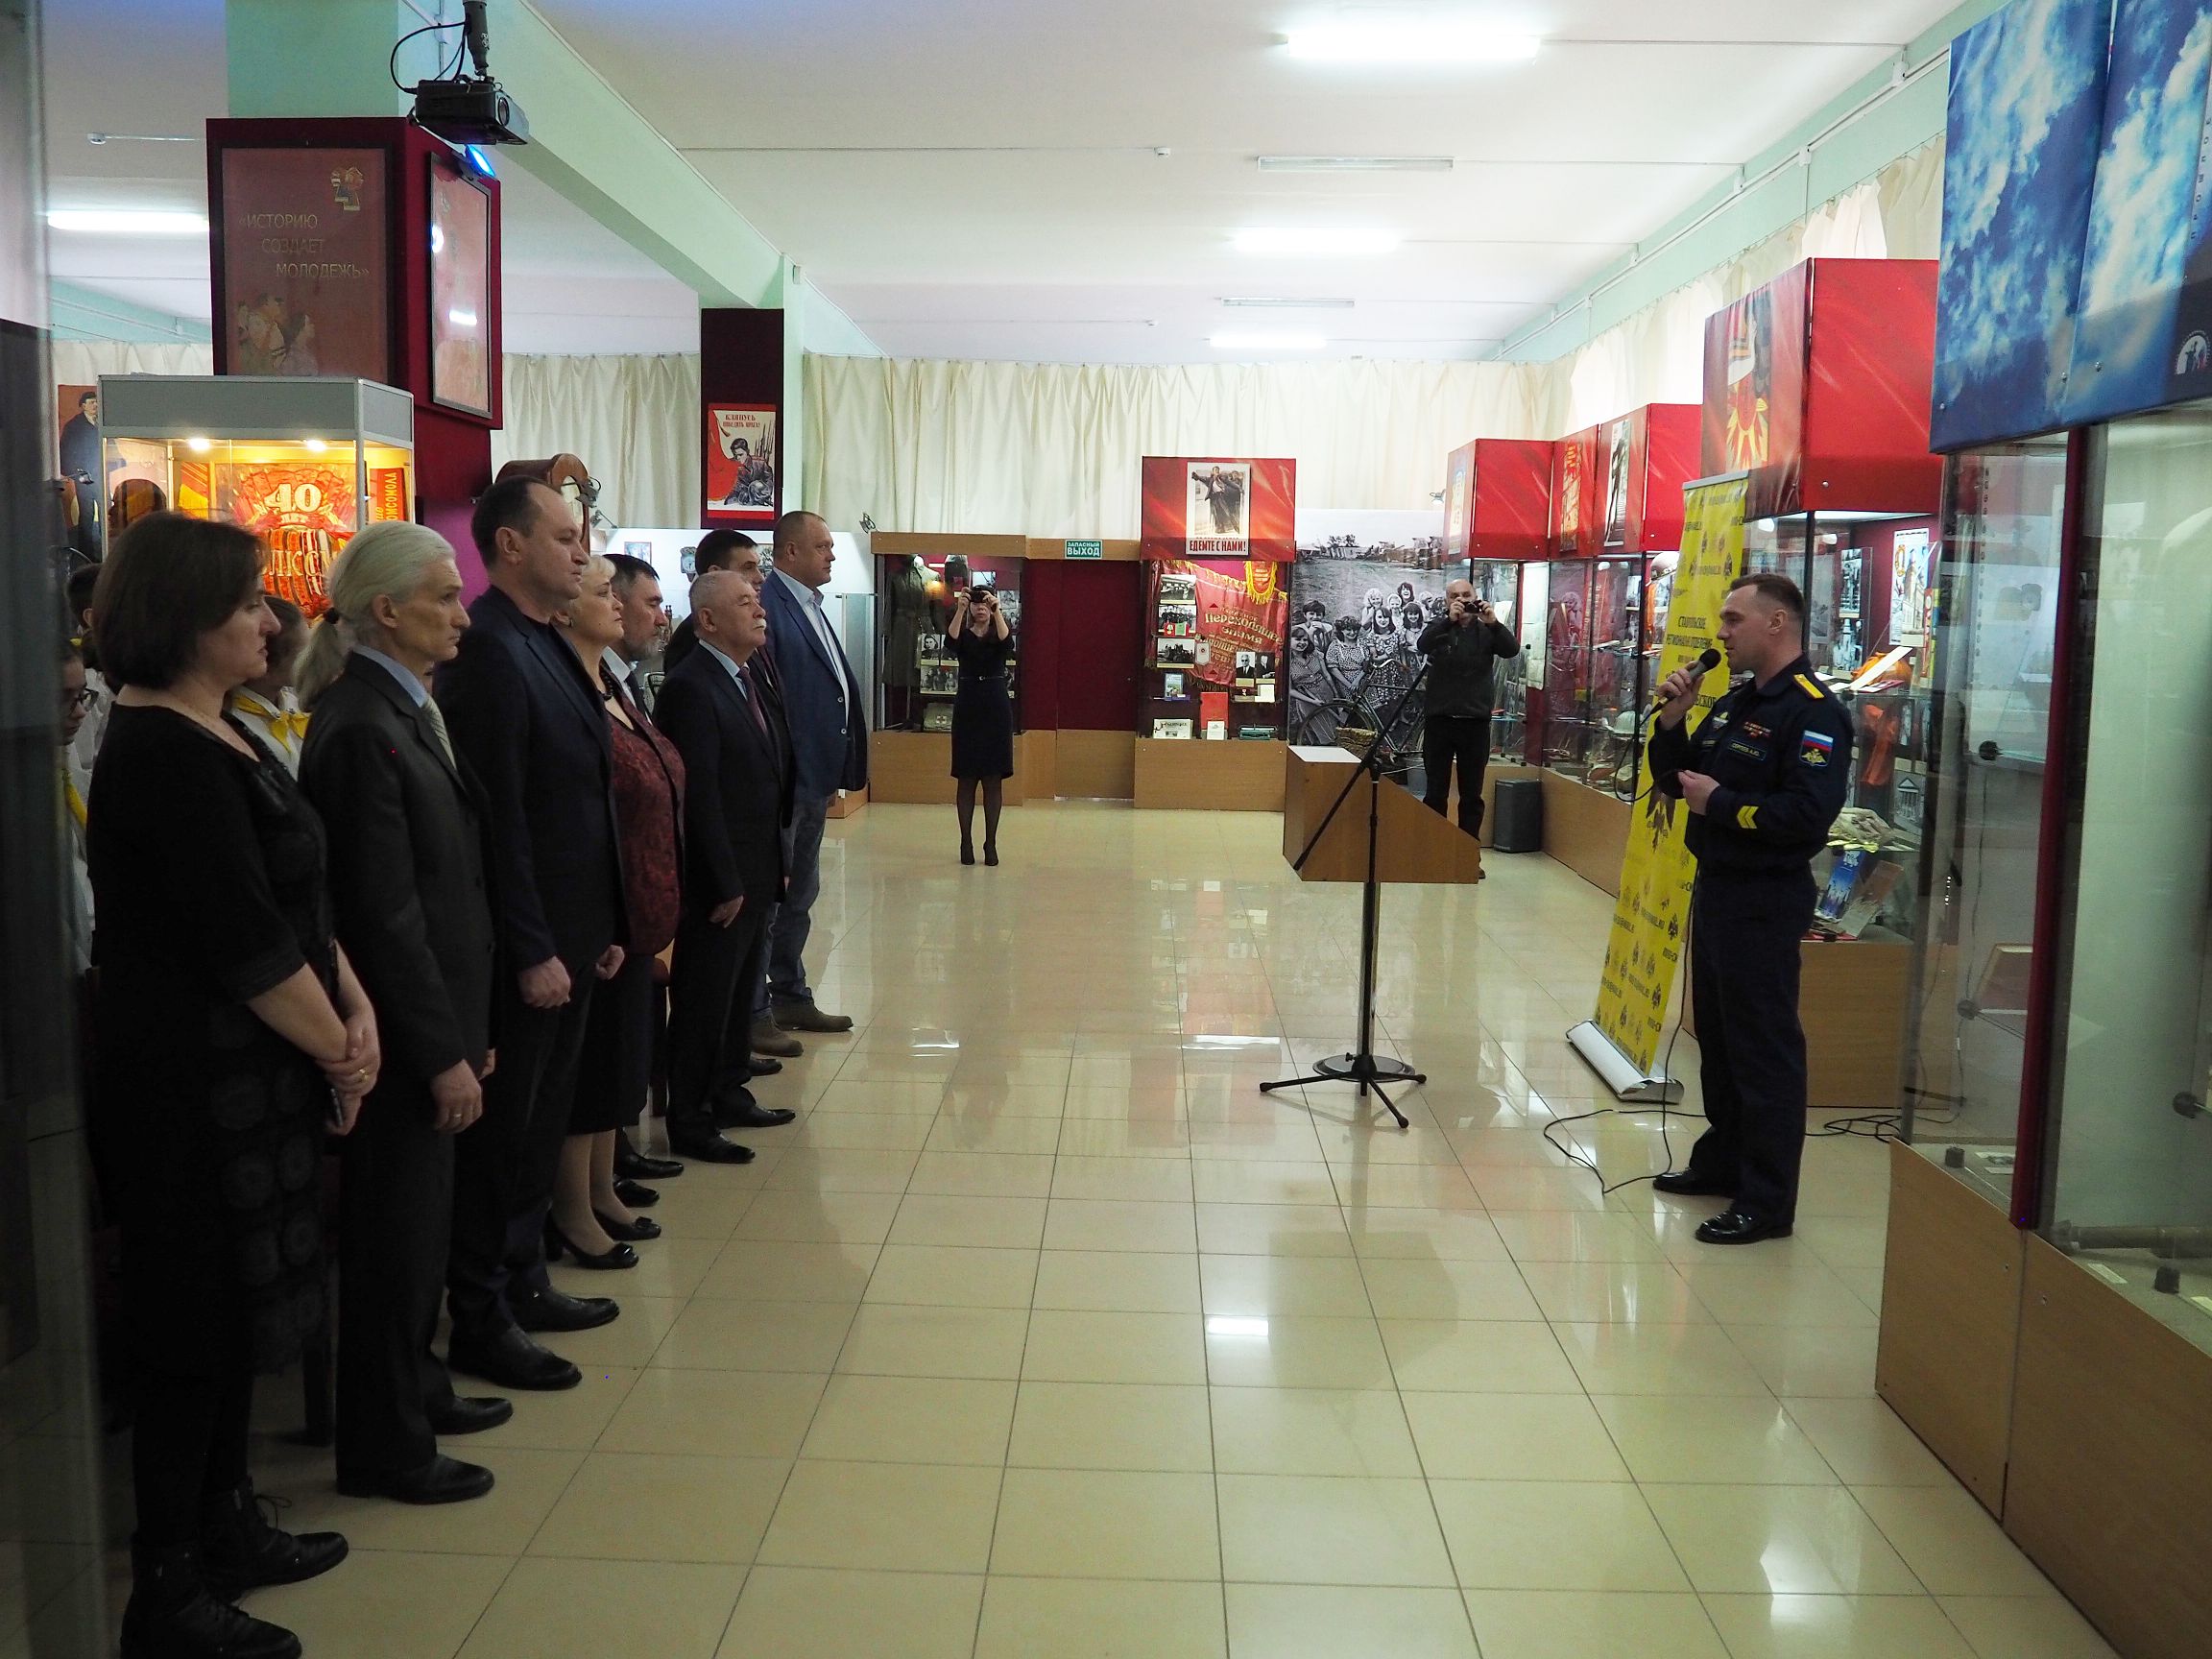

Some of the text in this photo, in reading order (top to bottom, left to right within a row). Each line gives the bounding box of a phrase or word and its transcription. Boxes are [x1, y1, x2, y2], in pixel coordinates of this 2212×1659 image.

[264, 483, 322, 513] 40
[384, 471, 398, 522] ОМСОМОЛА
[1067, 546, 1100, 557] ВЫХОД
[1221, 541, 1246, 552] НАМИ!
